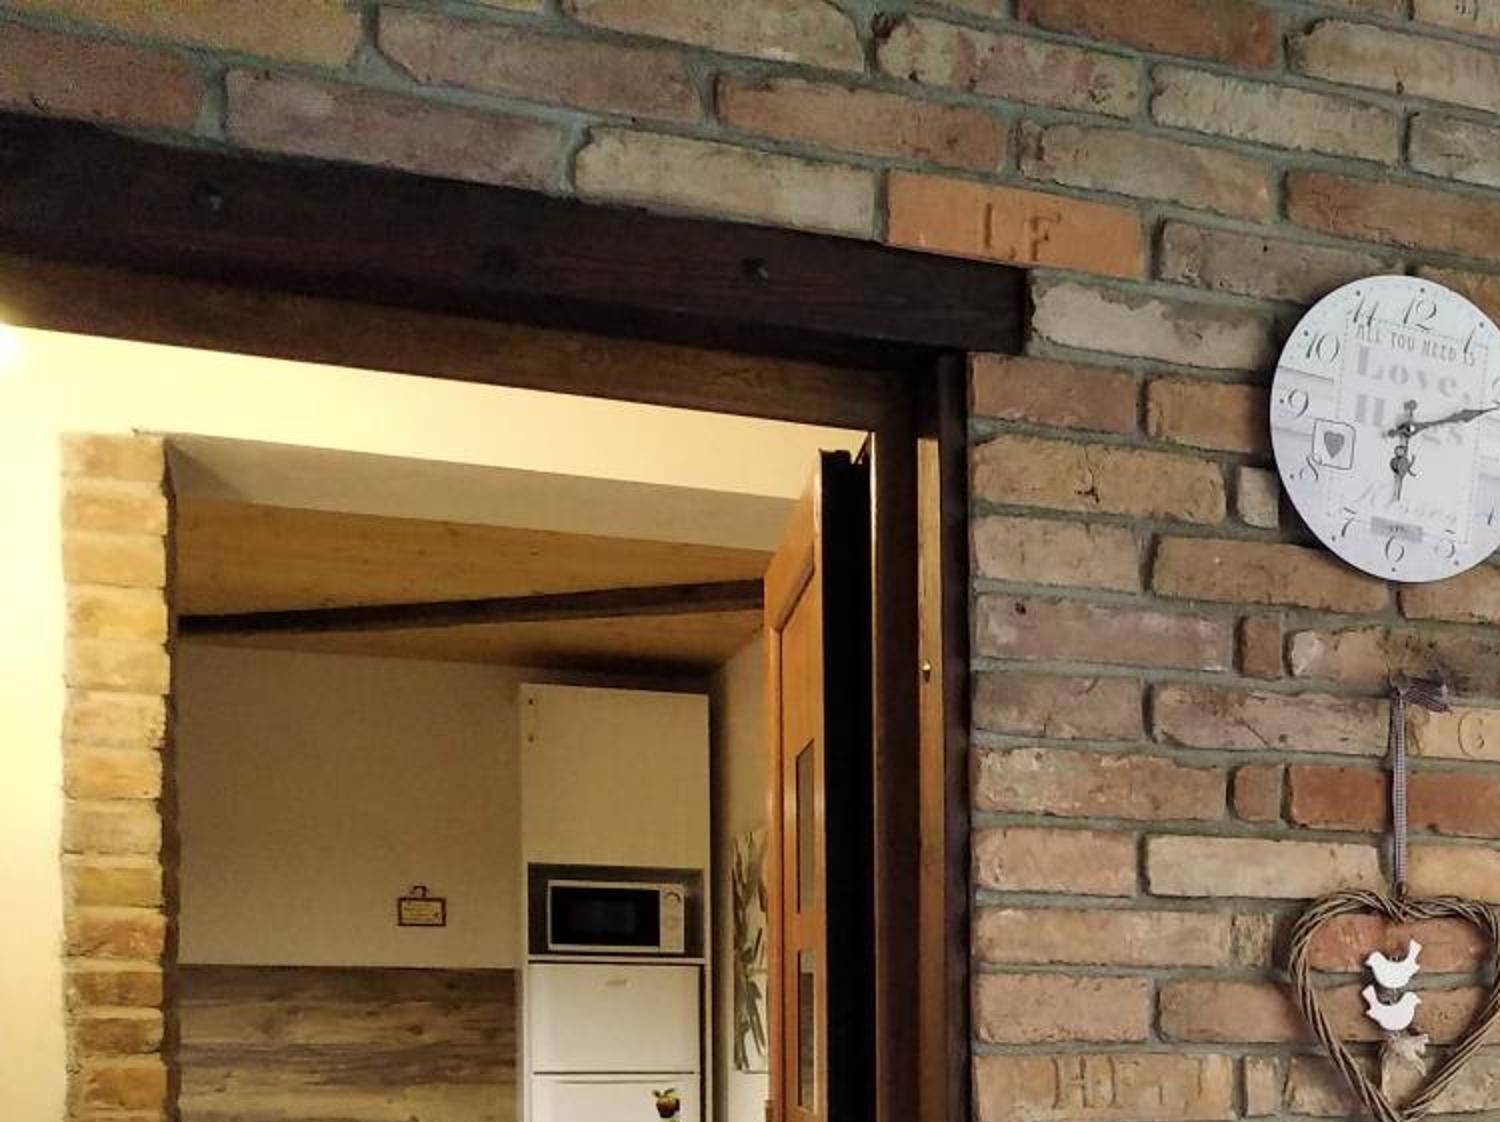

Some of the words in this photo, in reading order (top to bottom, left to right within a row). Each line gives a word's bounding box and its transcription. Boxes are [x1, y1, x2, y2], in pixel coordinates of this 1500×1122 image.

[1403, 297, 1438, 331] 12
[1305, 334, 1341, 363] 10
[1385, 534, 1405, 563] 6
